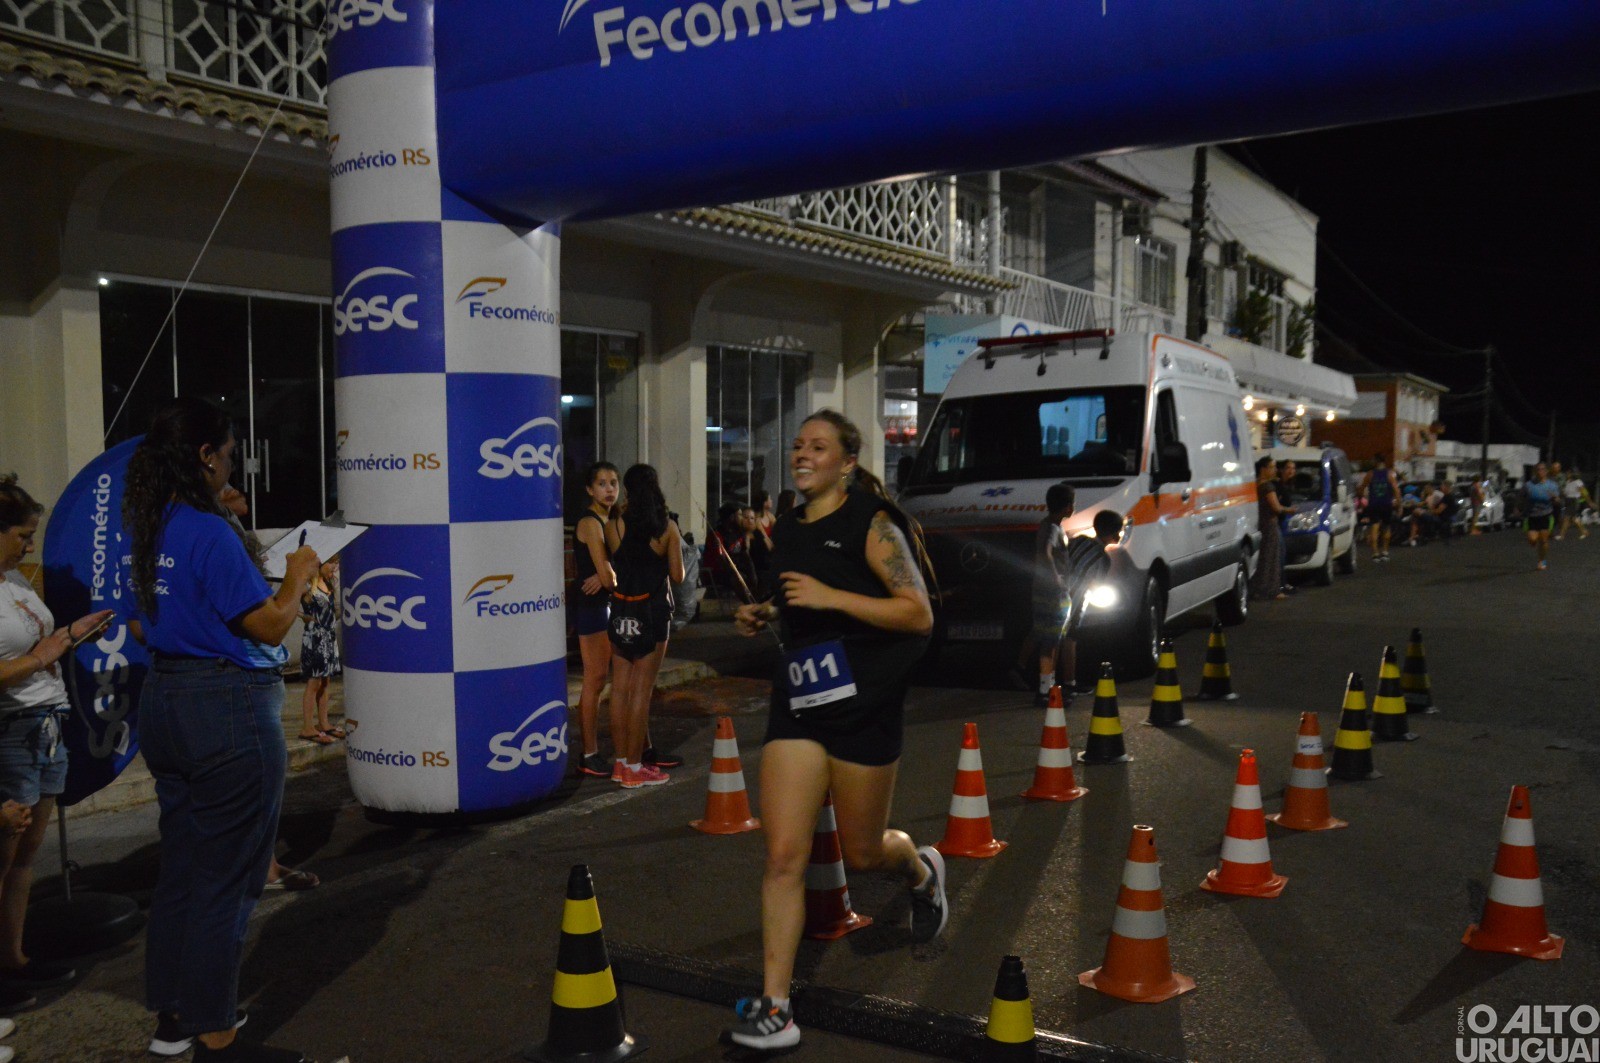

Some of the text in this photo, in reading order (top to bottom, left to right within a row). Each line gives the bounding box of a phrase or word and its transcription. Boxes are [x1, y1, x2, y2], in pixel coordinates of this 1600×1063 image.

[402, 148, 431, 166] RS
[470, 301, 554, 326] Fecomércio
[413, 453, 441, 470] RS
[90, 473, 111, 601] Fecomércio
[477, 594, 560, 618] Fecomércio
[788, 652, 840, 687] 011
[422, 751, 450, 768] RS
